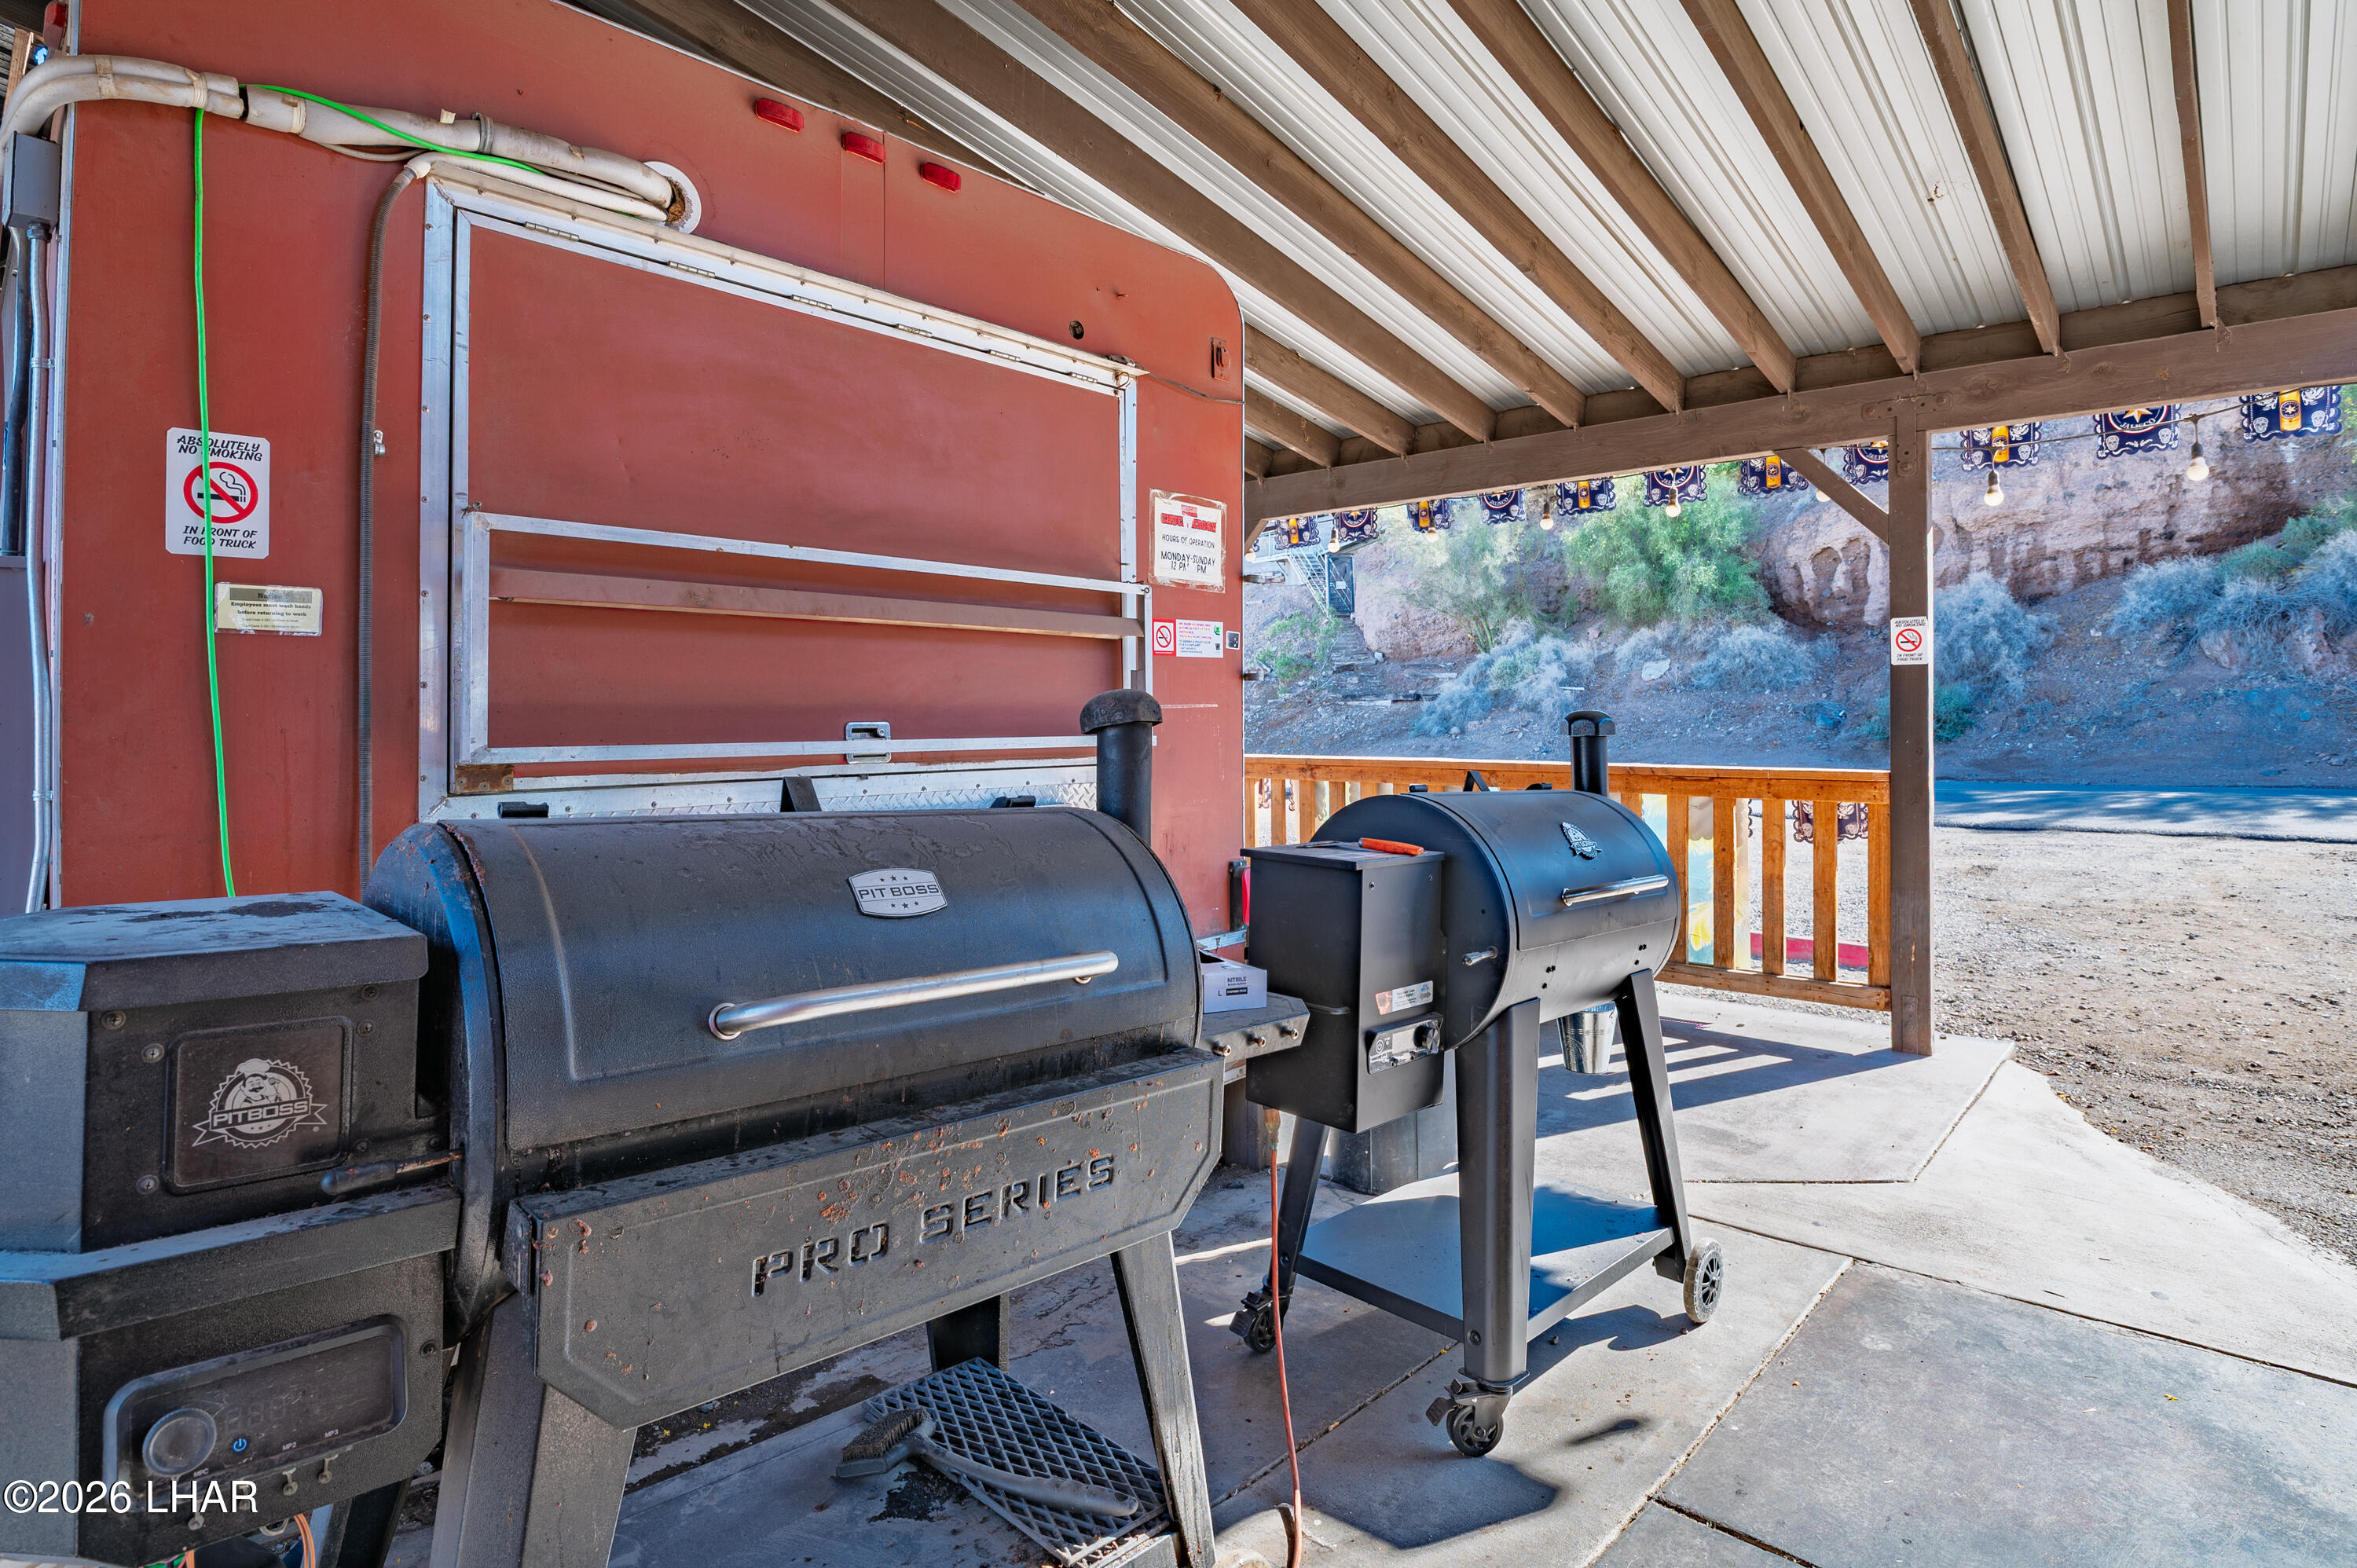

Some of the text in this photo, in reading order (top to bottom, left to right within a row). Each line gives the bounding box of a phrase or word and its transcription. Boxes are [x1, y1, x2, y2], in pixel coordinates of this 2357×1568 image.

[177, 434, 261, 452] ABSOLUTELY
[178, 445, 262, 462] NO MOKING
[183, 526, 198, 534] IN
[242, 529, 258, 538] OF
[219, 539, 257, 549] TRUCK
[1162, 534, 1179, 544] HOURS
[1189, 538, 1215, 549] OPERATION
[1160, 551, 1215, 566] MONDAY-SUNDAY
[1197, 565, 1207, 574] PM
[858, 884, 940, 899] PIT BOSS
[750, 1153, 1114, 1298] PRO SERIES
[324, 1429, 339, 1438] MP3
[282, 1442, 297, 1451] MP2
